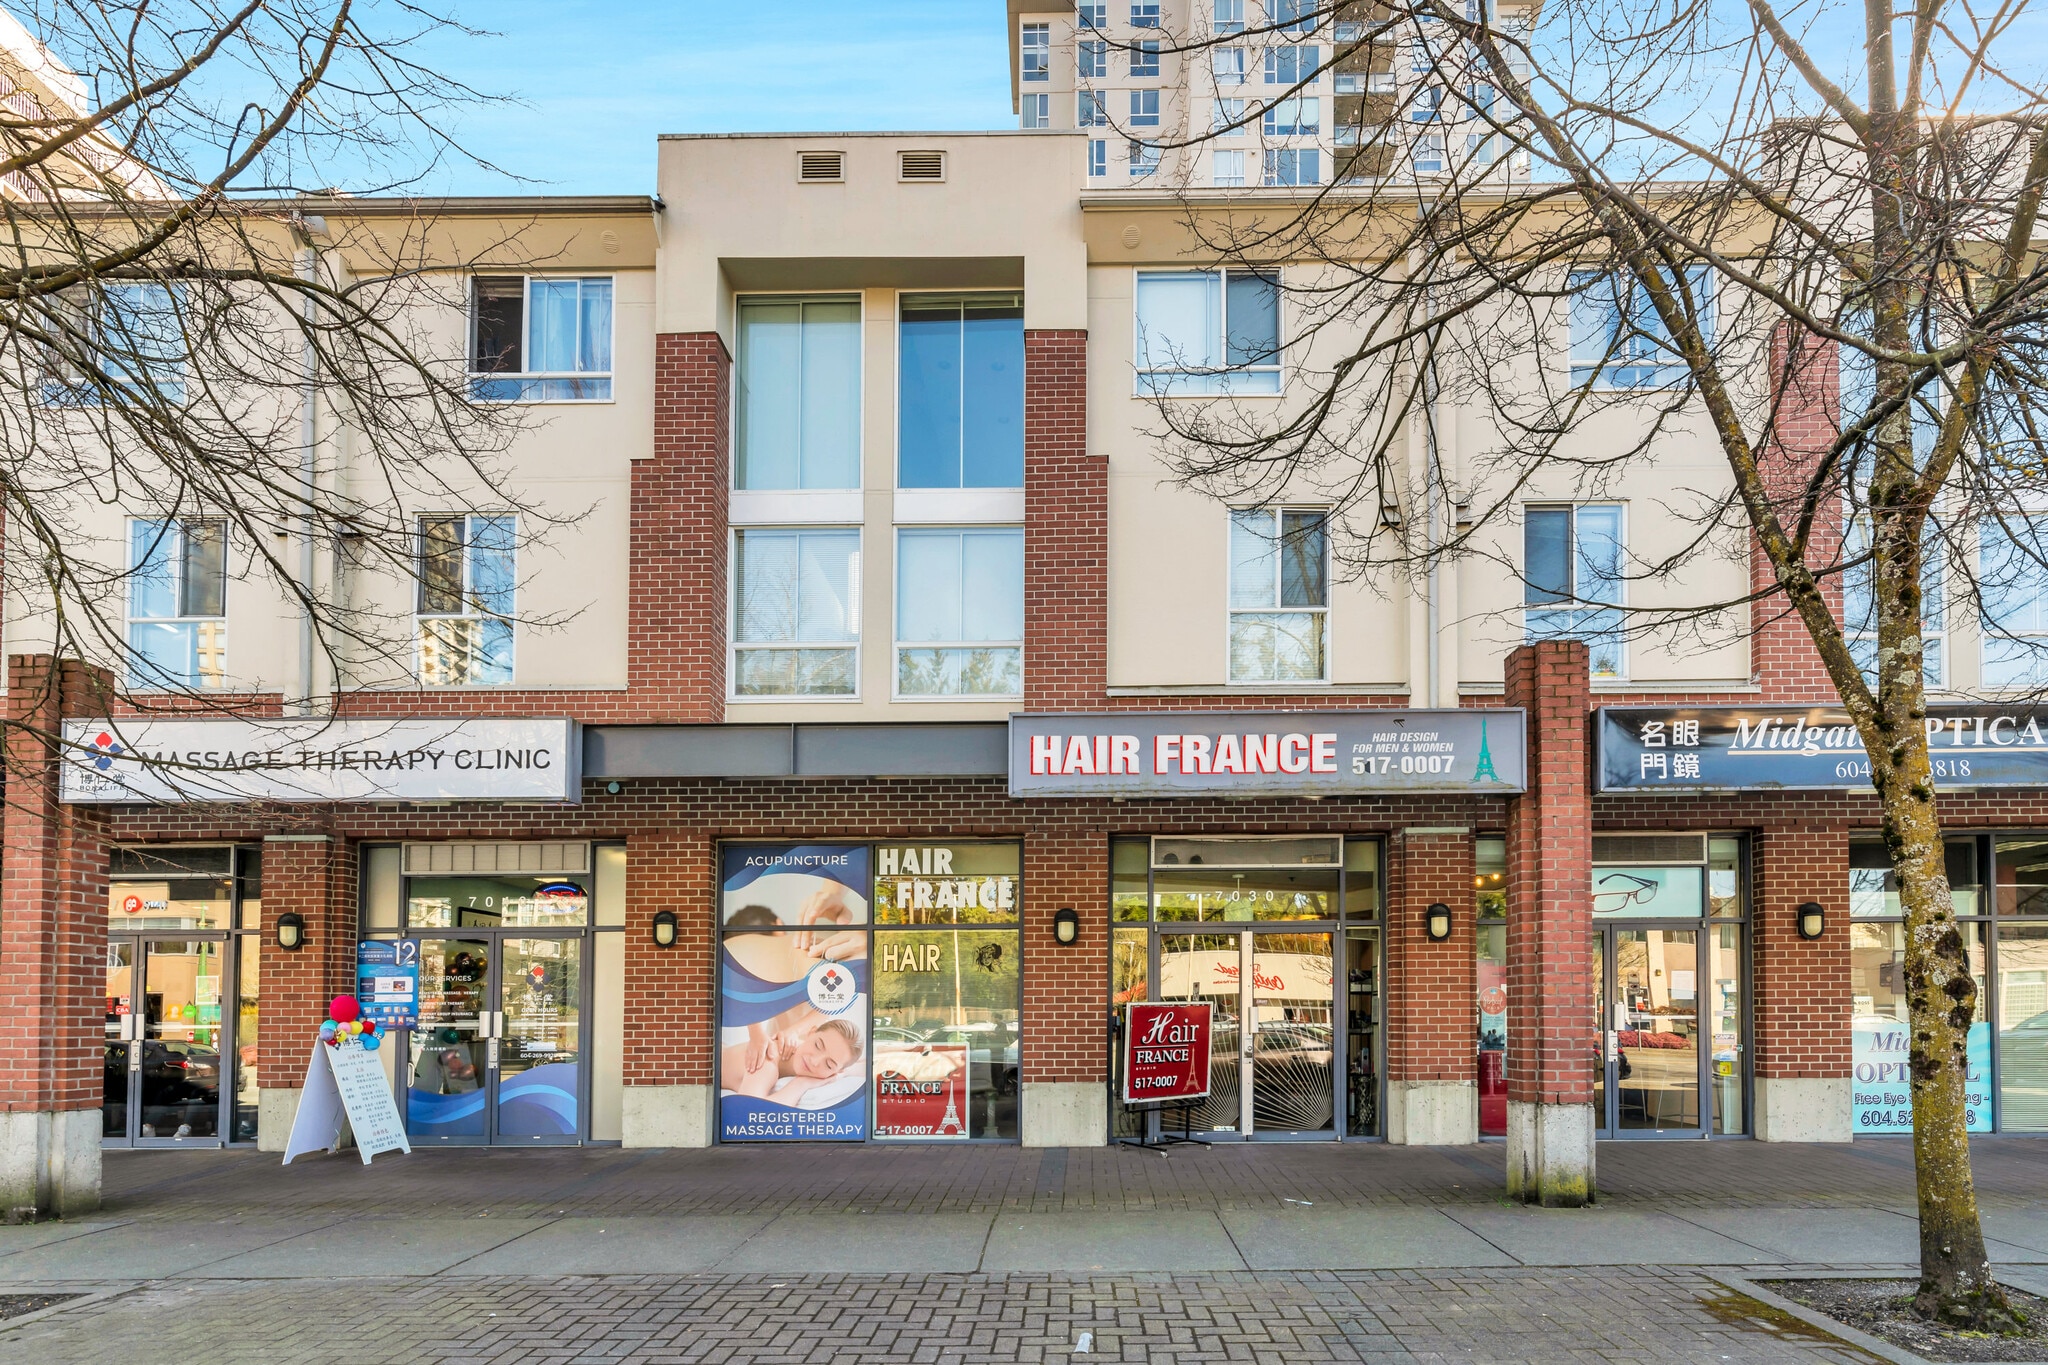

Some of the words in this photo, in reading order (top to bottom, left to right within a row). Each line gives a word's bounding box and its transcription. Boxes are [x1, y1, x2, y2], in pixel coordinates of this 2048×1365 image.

[1372, 732, 1397, 743] HAIR
[1400, 732, 1439, 743] DESIGN
[1729, 717, 1865, 757] Midgat
[1925, 716, 2047, 746] PTICA
[1030, 735, 1140, 776] HAIR
[1154, 733, 1338, 775] FRANCE
[1352, 744, 1373, 754] FOR
[1375, 743, 1399, 753] MEN
[1402, 743, 1410, 753] &
[1412, 742, 1454, 753] WOMEN
[140, 751, 283, 772] MASSAGE
[299, 750, 445, 771] THERAPY
[455, 749, 551, 770] CLINIC
[1352, 755, 1455, 775] 517-0007
[745, 855, 849, 867] ACUPUNCTURE
[878, 848, 954, 875] HAIR
[897, 880, 1014, 910] FRANCE
[1215, 890, 1274, 902] 7030
[393, 942, 416, 965] 12
[883, 944, 942, 972] HAIR
[1142, 1011, 1200, 1044] Hair
[1136, 1049, 1189, 1064] FRANCE
[881, 1082, 943, 1095] FRANCE
[1135, 1075, 1178, 1090] 517-0007
[1854, 1093, 1881, 1105] Free
[1884, 1093, 1906, 1106] Eye
[748, 1112, 837, 1124] REGISTERED
[726, 1125, 793, 1136] MASSAGE
[798, 1124, 863, 1136] THERAPY
